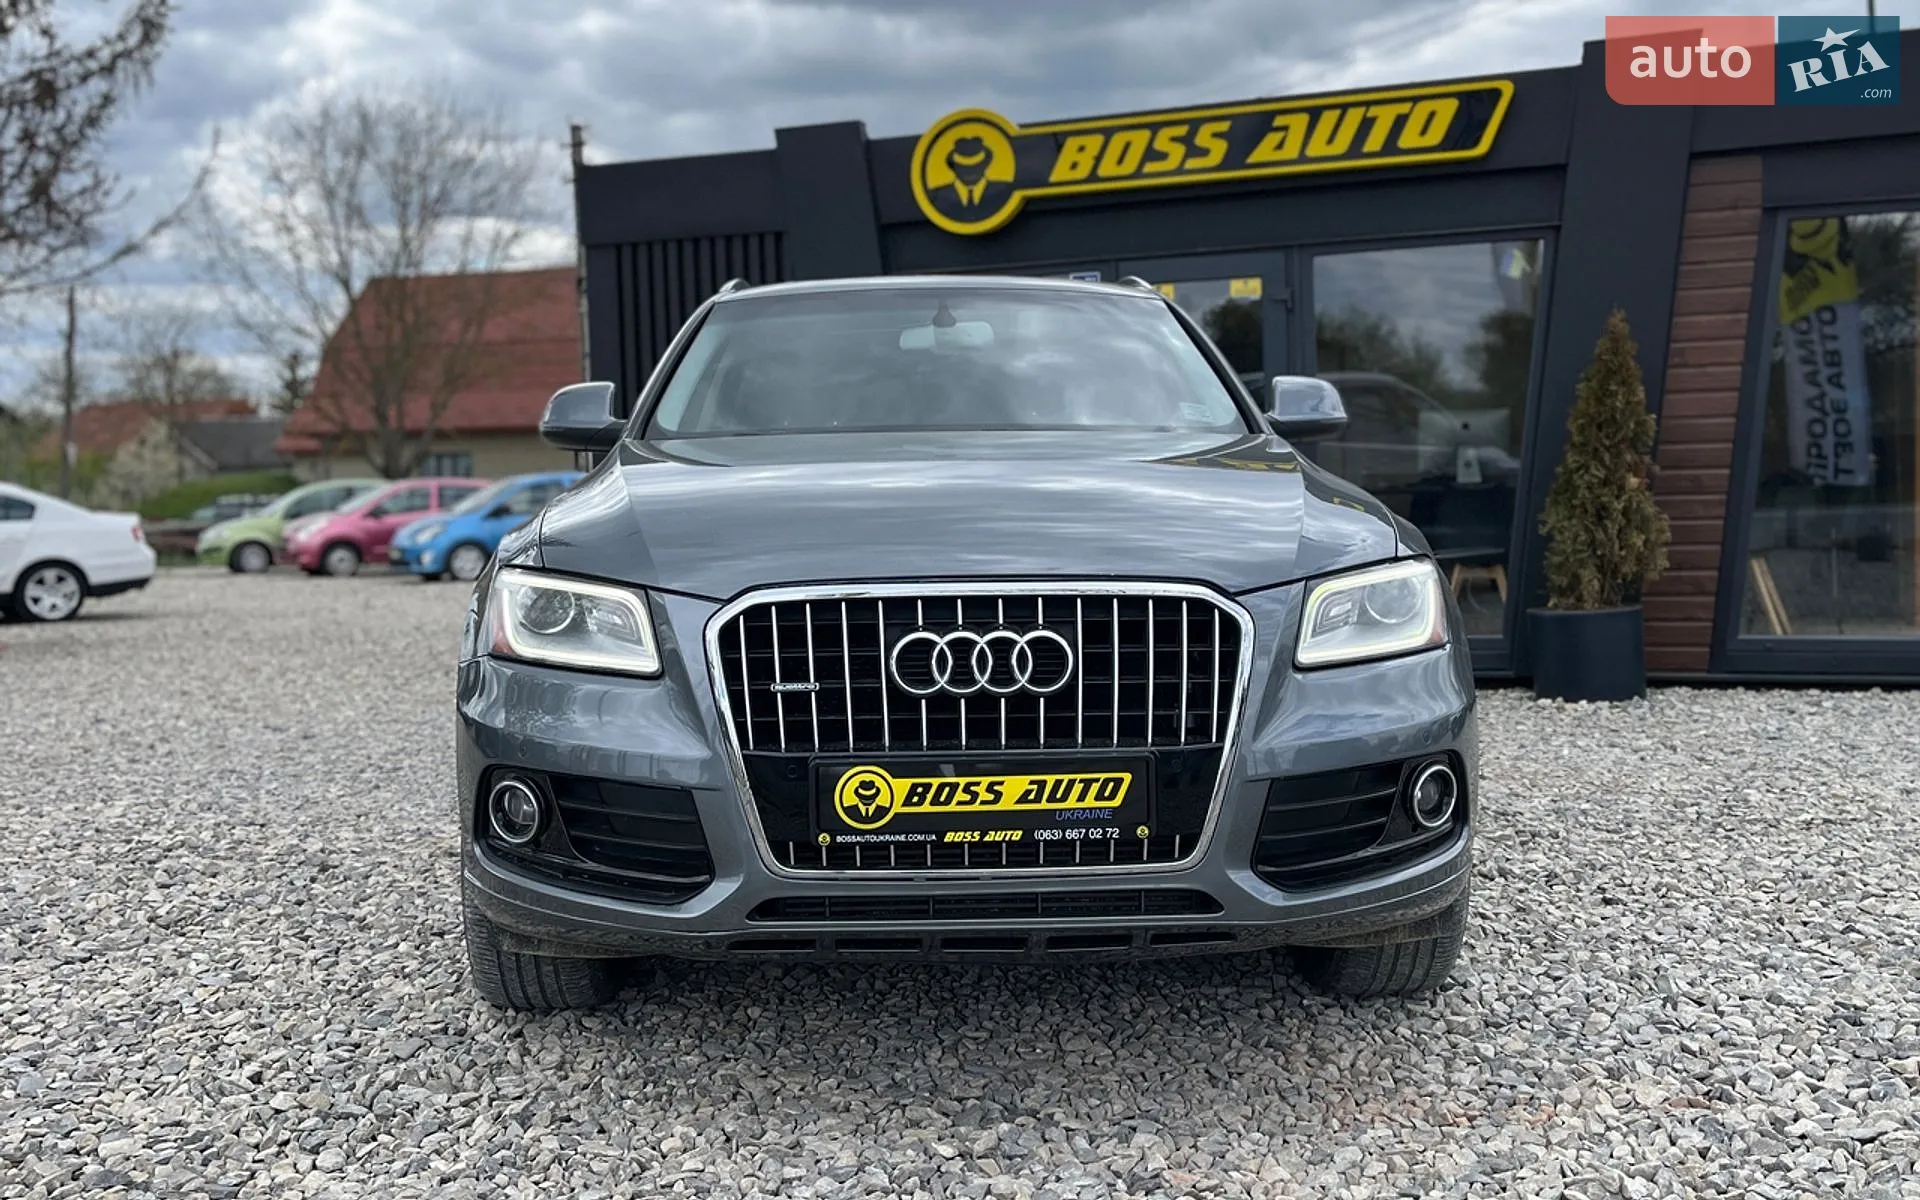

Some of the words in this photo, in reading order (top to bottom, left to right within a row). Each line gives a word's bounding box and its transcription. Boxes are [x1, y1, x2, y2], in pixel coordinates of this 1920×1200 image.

[1050, 121, 1231, 183] BOSS
[1247, 97, 1459, 163] AUTO
[1816, 304, 1846, 391] АВТО
[901, 781, 1005, 807] BOSS
[1014, 777, 1125, 805] AUTO
[1056, 808, 1113, 821] UKRAINE
[836, 833, 937, 843] BOSSAUTOUKRAINE.COM.UA
[944, 831, 981, 843] BOSS
[983, 830, 1023, 842] AUTO
[1034, 829, 1063, 841] (063)
[1065, 829, 1085, 839] 667
[1088, 828, 1103, 839] 02
[1106, 827, 1120, 839] 72
